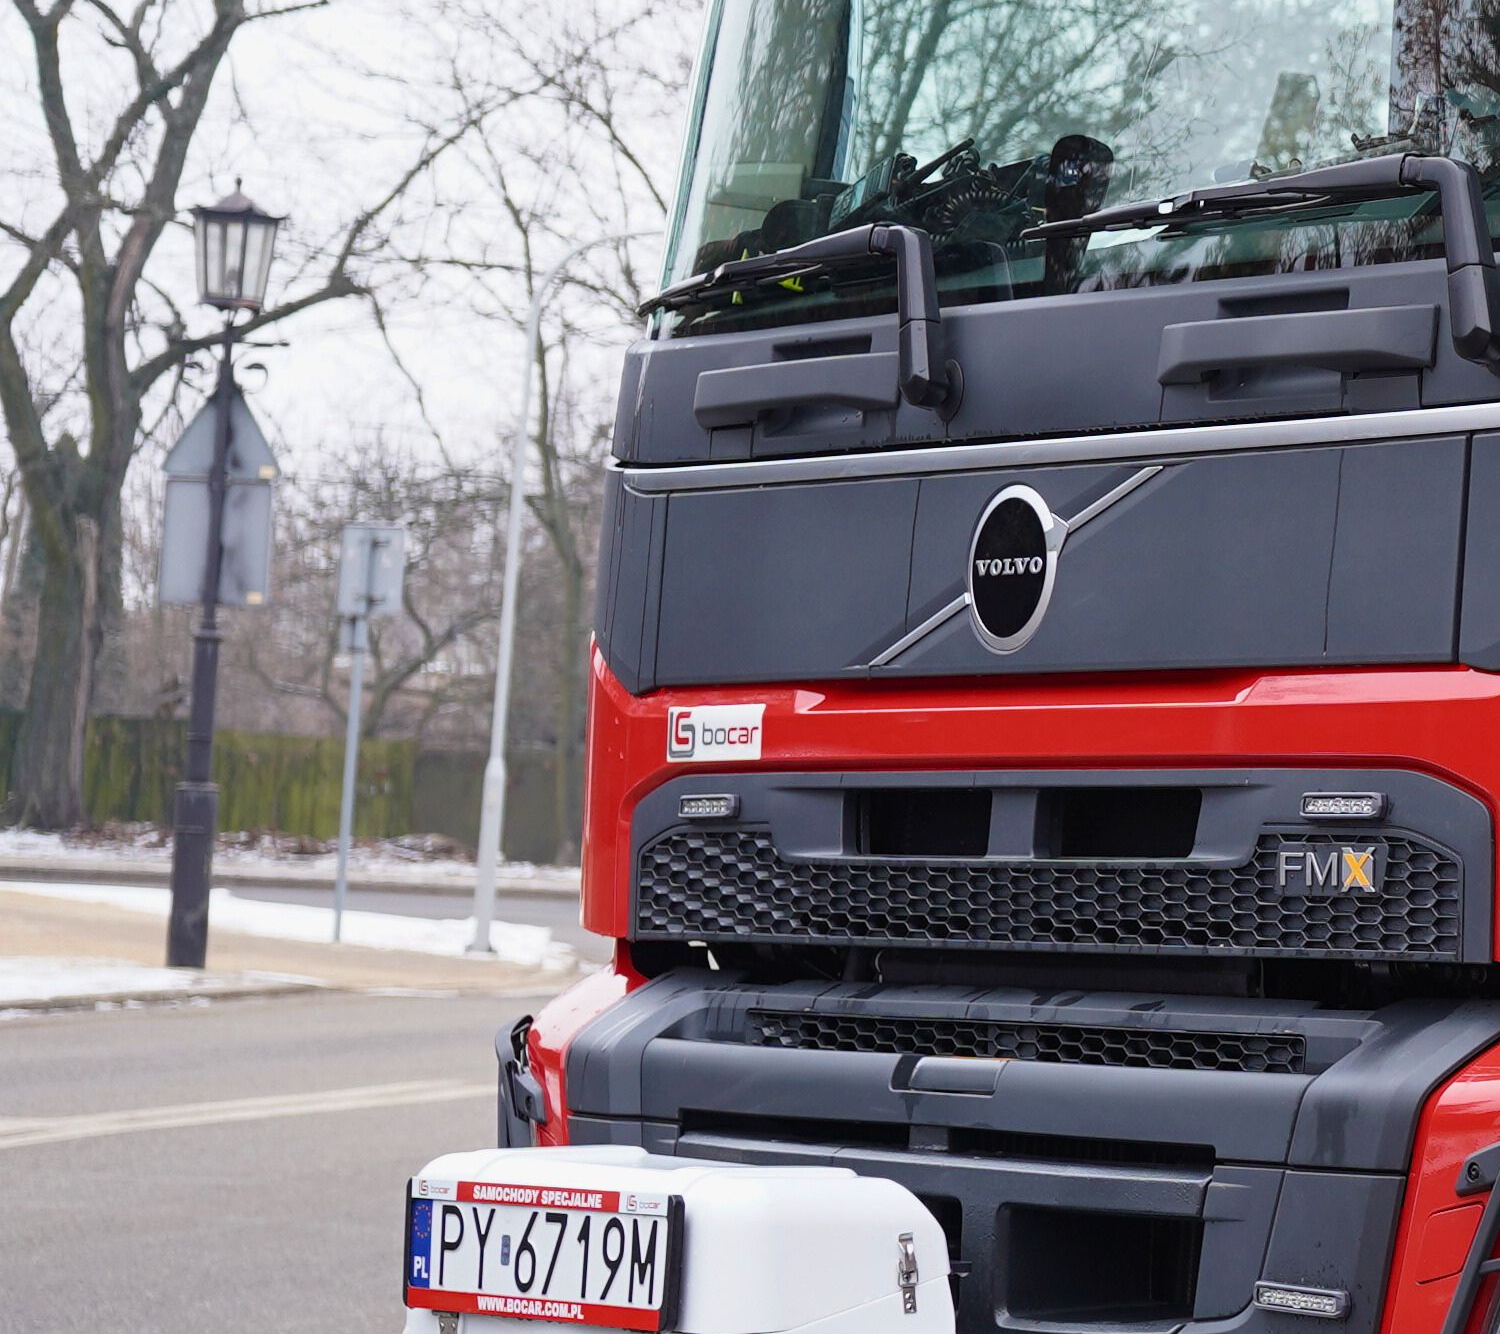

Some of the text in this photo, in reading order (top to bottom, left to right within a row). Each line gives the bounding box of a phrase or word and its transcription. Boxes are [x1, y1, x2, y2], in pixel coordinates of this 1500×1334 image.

[975, 556, 1043, 577] VOLVO
[702, 722, 759, 746] bocar
[1279, 847, 1376, 893] FMX
[472, 1185, 603, 1209] SAMOCHODY SPECJALNE
[439, 1204, 658, 1305] PY 6719M
[413, 1255, 429, 1279] PL
[476, 1295, 585, 1320] WWW.BOCAR.COM.PL
